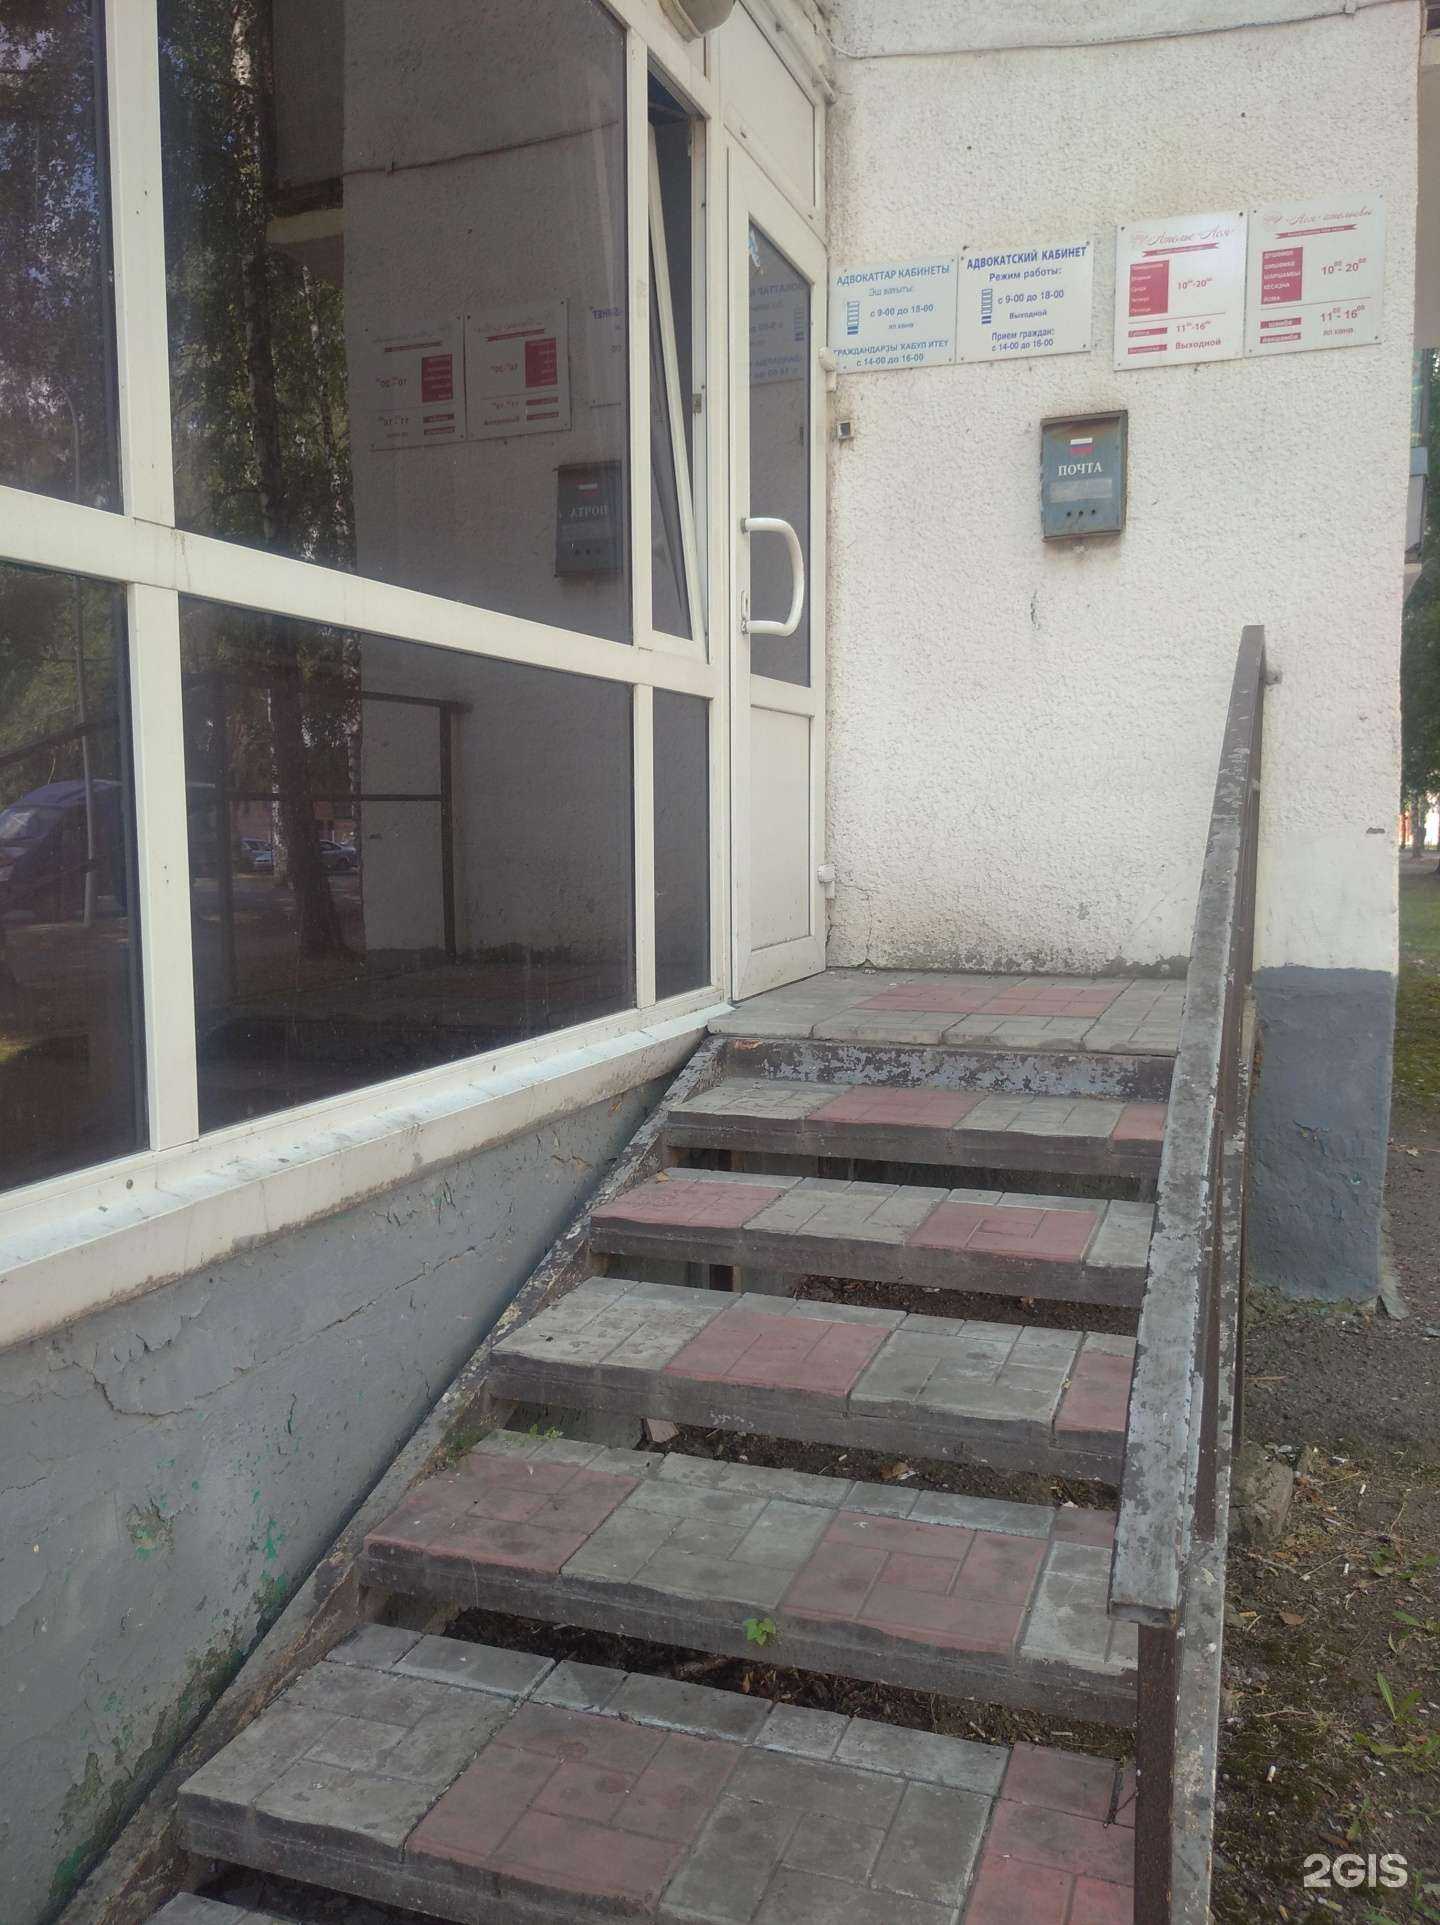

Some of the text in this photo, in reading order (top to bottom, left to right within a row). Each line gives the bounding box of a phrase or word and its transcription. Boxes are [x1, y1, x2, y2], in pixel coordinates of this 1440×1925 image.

[967, 246, 1087, 270] АДВОКАТСКИЙ КАБИНЕТ
[836, 264, 950, 286] АДВОКАТТАР КАБИНЕТЫ
[989, 267, 1062, 282] Режим работы:
[1005, 294, 1024, 304] 9-00
[1026, 294, 1038, 303] до
[1041, 289, 1064, 300] 18-00
[877, 307, 895, 317] 9-00
[897, 307, 909, 316] до
[911, 303, 934, 314] 18-00
[1009, 309, 1047, 320] Выходной
[991, 328, 1056, 342] Прием граждан:
[998, 342, 1019, 351] 14-00
[1020, 341, 1031, 350] до
[1033, 339, 1054, 348] 16-00
[1175, 338, 1222, 350] Выходной
[864, 356, 887, 366] 14-00
[887, 356, 899, 365] до
[902, 353, 924, 363] 16-00
[1058, 462, 1103, 476] ПОЧТА
